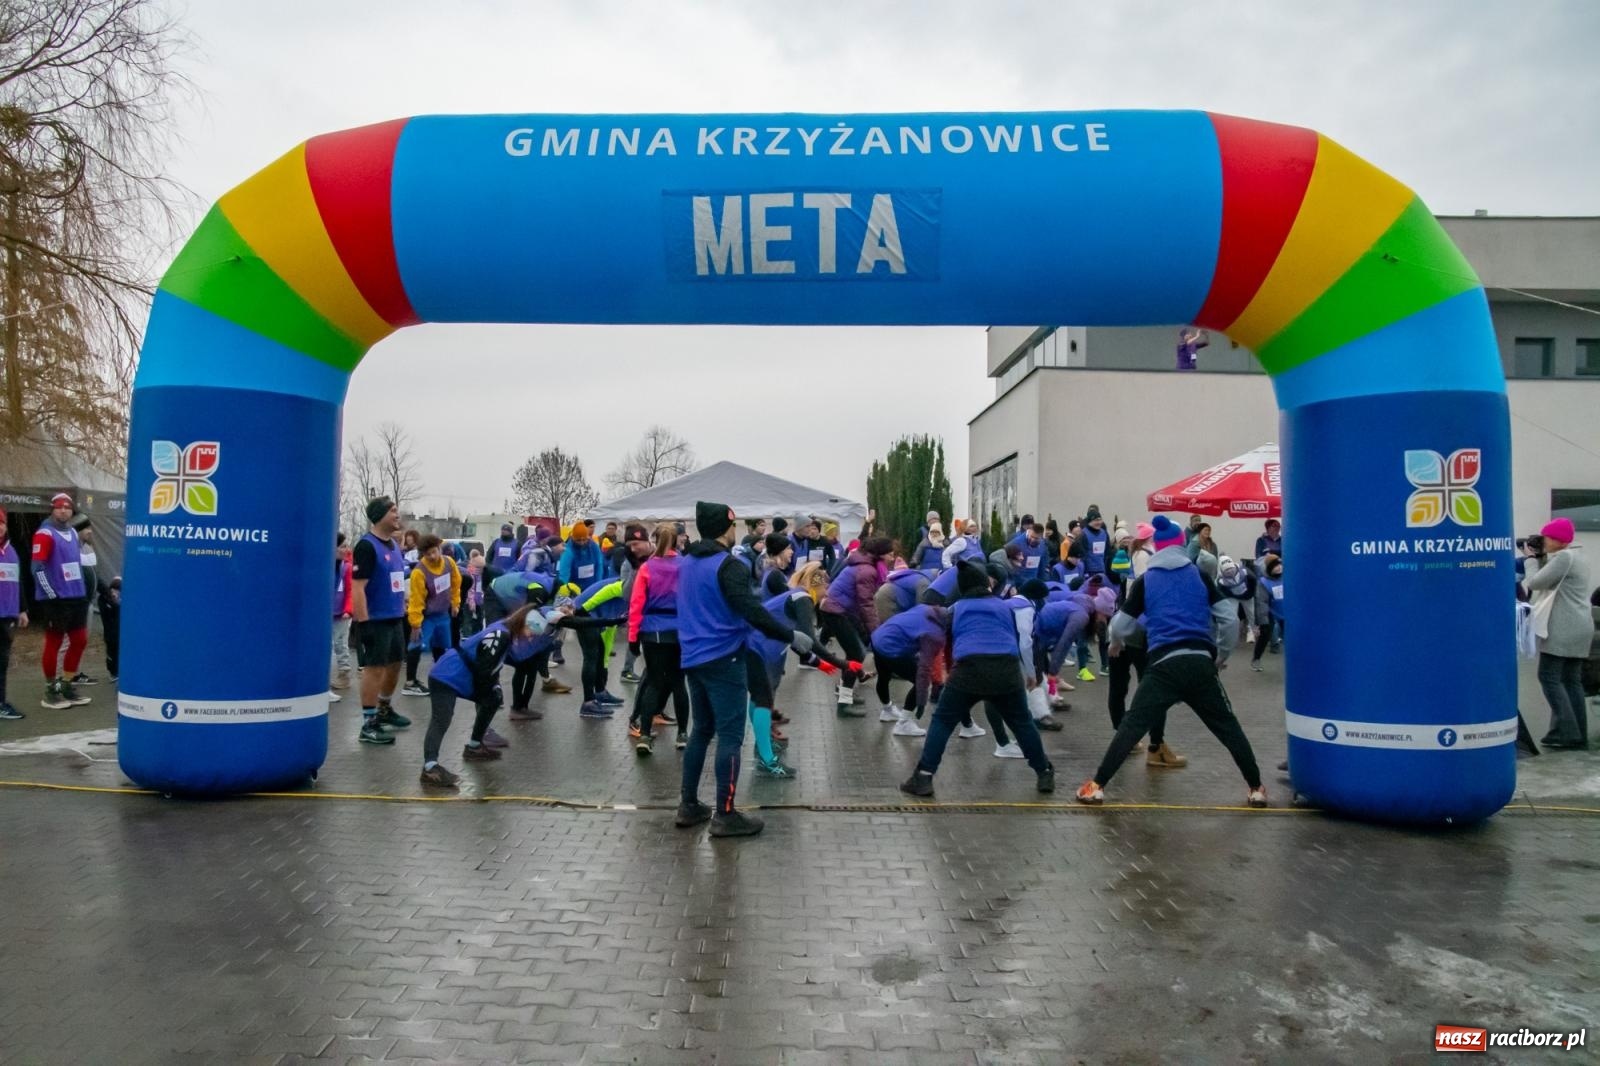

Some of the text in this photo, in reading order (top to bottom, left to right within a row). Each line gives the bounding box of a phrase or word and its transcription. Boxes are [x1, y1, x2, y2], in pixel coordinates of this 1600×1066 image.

[504, 122, 1110, 157] GMINA KRZYŻANOWICE
[693, 192, 907, 276] META
[1233, 503, 1266, 511] WARKA
[152, 523, 269, 543] KRZYŻANOWICE
[186, 547, 233, 557] zapamiętaj
[1351, 535, 1512, 555] GMINA KRZYŻANOWICE
